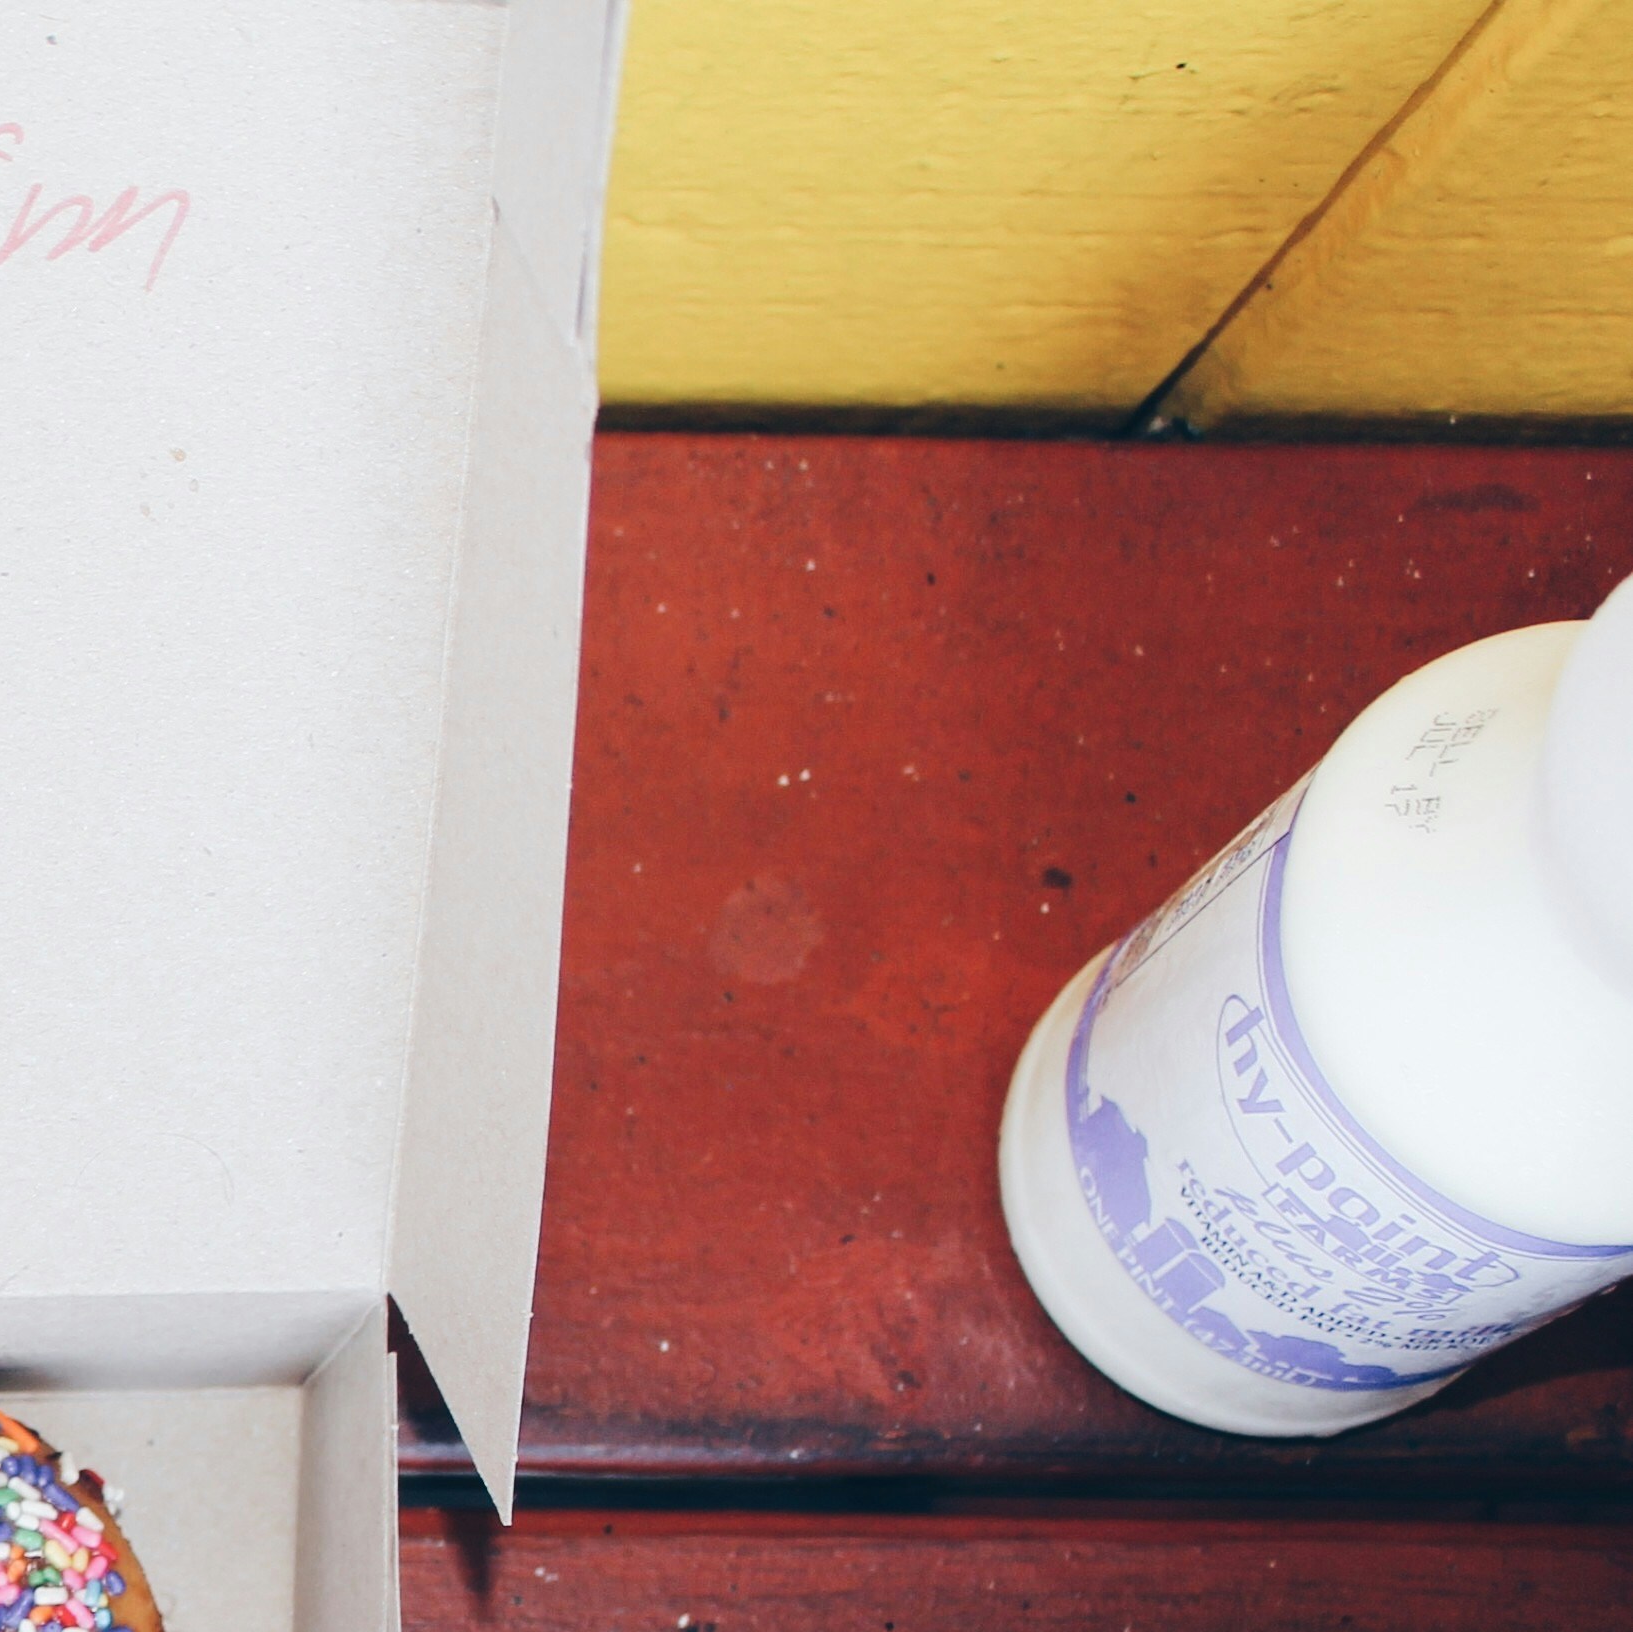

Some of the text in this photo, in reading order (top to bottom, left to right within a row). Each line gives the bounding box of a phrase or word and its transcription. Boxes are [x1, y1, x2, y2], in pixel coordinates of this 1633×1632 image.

[1225, 1006, 1501, 1281] hy-point
[1079, 1165, 1120, 1241] ONE
[1116, 1244, 1176, 1312] PINT
[1177, 1159, 1324, 1300] reduced
[1180, 1185, 1249, 1267] VITAMIN
[1200, 1235, 1295, 1314] REDUCED
[1212, 1185, 1335, 1284] plus
[1276, 1199, 1447, 1300] FARMS
